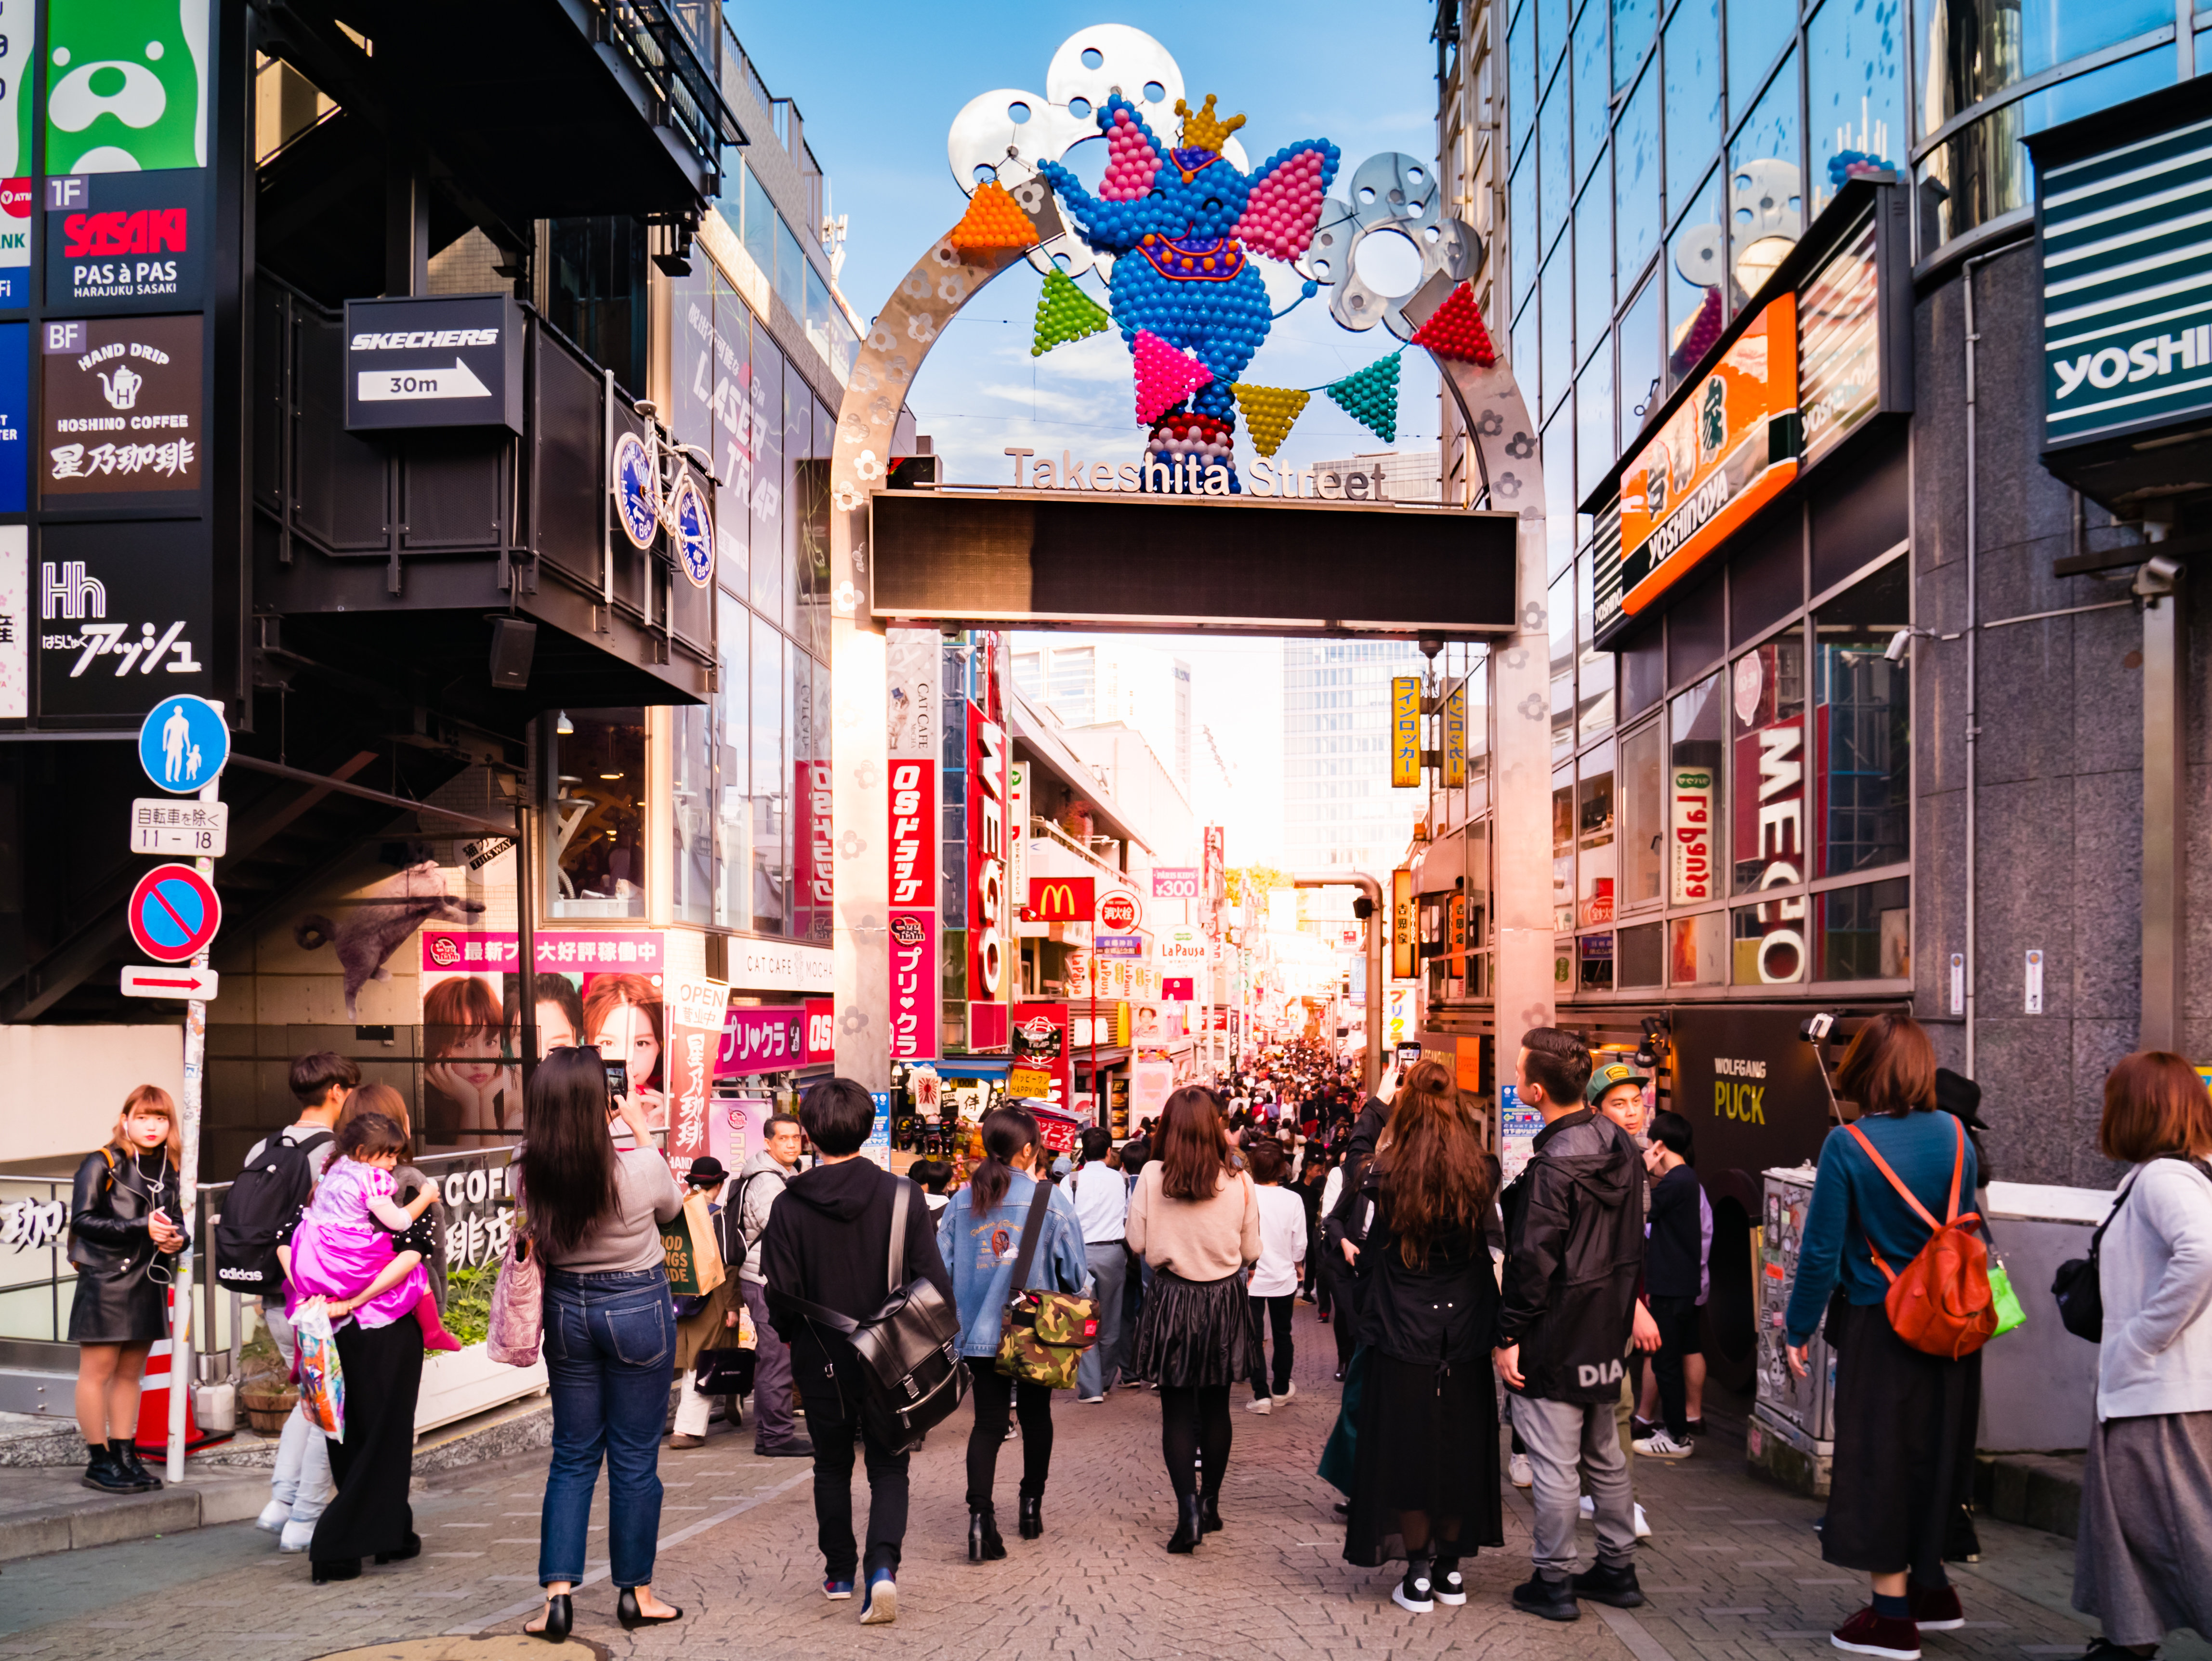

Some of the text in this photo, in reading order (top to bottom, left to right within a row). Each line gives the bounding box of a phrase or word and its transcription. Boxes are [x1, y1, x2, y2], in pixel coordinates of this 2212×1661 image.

[52, 180, 81, 207] 1F
[0, 234, 25, 249] NK
[64, 208, 187, 258] SASAKI
[74, 261, 177, 286] PAS à PAS
[74, 283, 176, 298] HARAJUKU SASAKI
[49, 324, 78, 349] BF
[350, 329, 499, 350] SKECHERS
[78, 343, 170, 371] HAND DRIP
[2053, 323, 2212, 399] YOSHI
[390, 377, 437, 394] 30m
[693, 350, 766, 462] LASER
[58, 415, 188, 432] HOSHINO COFFEE
[51, 437, 195, 479] 星乃珈琲
[724, 441, 780, 523] TRAP
[1004, 447, 1388, 501] Takeshita Street
[1648, 470, 1728, 569] YOSHINOYA
[1595, 586, 1622, 626] YOSHINO
[70, 621, 202, 677] アッシュ
[918, 684, 929, 749] CAT CAFE
[1398, 680, 1417, 772] コインロッカー
[138, 807, 219, 827] 自転車を除く
[893, 765, 922, 902] OSドラッグ
[473, 838, 512, 868] THIS WAY
[1156, 881, 1195, 896] ¥300
[1104, 907, 1132, 920] 消火栓
[464, 941, 657, 962] 最新プ 大好評稼働中
[1162, 944, 1173, 956] La
[1176, 944, 1204, 957] Pausa
[747, 956, 833, 979] CAT CAFE MOCHA
[681, 984, 724, 1008] OPEN
[1389, 989, 1407, 1047] プリクラ
[1013, 1073, 1049, 1085] ハッピーワン
[1714, 1058, 1766, 1078] WOLFGANG
[676, 1033, 705, 1152] 星乃珈琲
[1012, 1085, 1047, 1097] HAPPY ONE
[1714, 1081, 1765, 1125] PUCK
[669, 1156, 693, 1169] HAND
[219, 1268, 263, 1281] adidas
